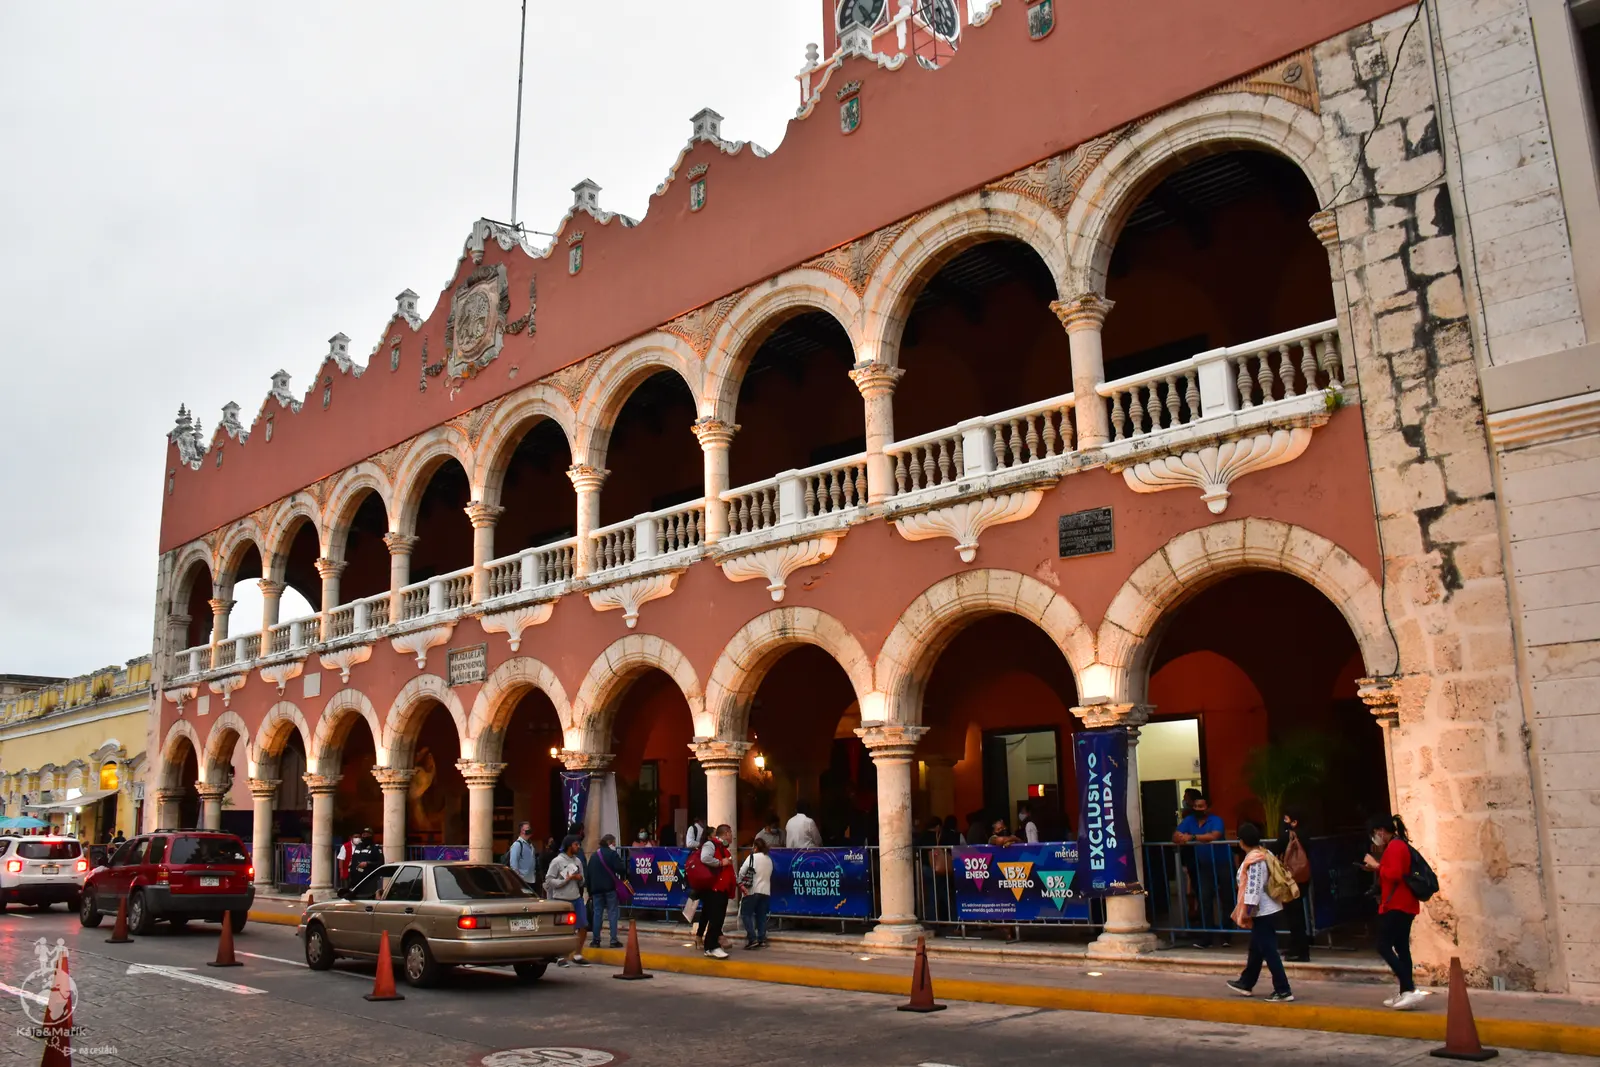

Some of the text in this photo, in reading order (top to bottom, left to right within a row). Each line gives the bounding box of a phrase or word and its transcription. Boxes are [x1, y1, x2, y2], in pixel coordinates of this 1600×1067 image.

[1087, 752, 1105, 870] EXCLUSIVO
[1102, 771, 1117, 849] SALIDA
[635, 857, 652, 868] 30%
[965, 857, 988, 870] 30%
[636, 867, 653, 875] ENERO
[660, 865, 674, 875] 15%
[1004, 866, 1026, 879] 15%
[792, 871, 840, 879] TRABAJAMOS
[965, 871, 990, 879] ENERO
[793, 879, 841, 888] AL RITMO DE
[998, 880, 1034, 888] FEBRERO
[1046, 876, 1066, 888] 8%
[793, 887, 841, 896] TU PREDIAL
[1041, 889, 1074, 898] MARZO
